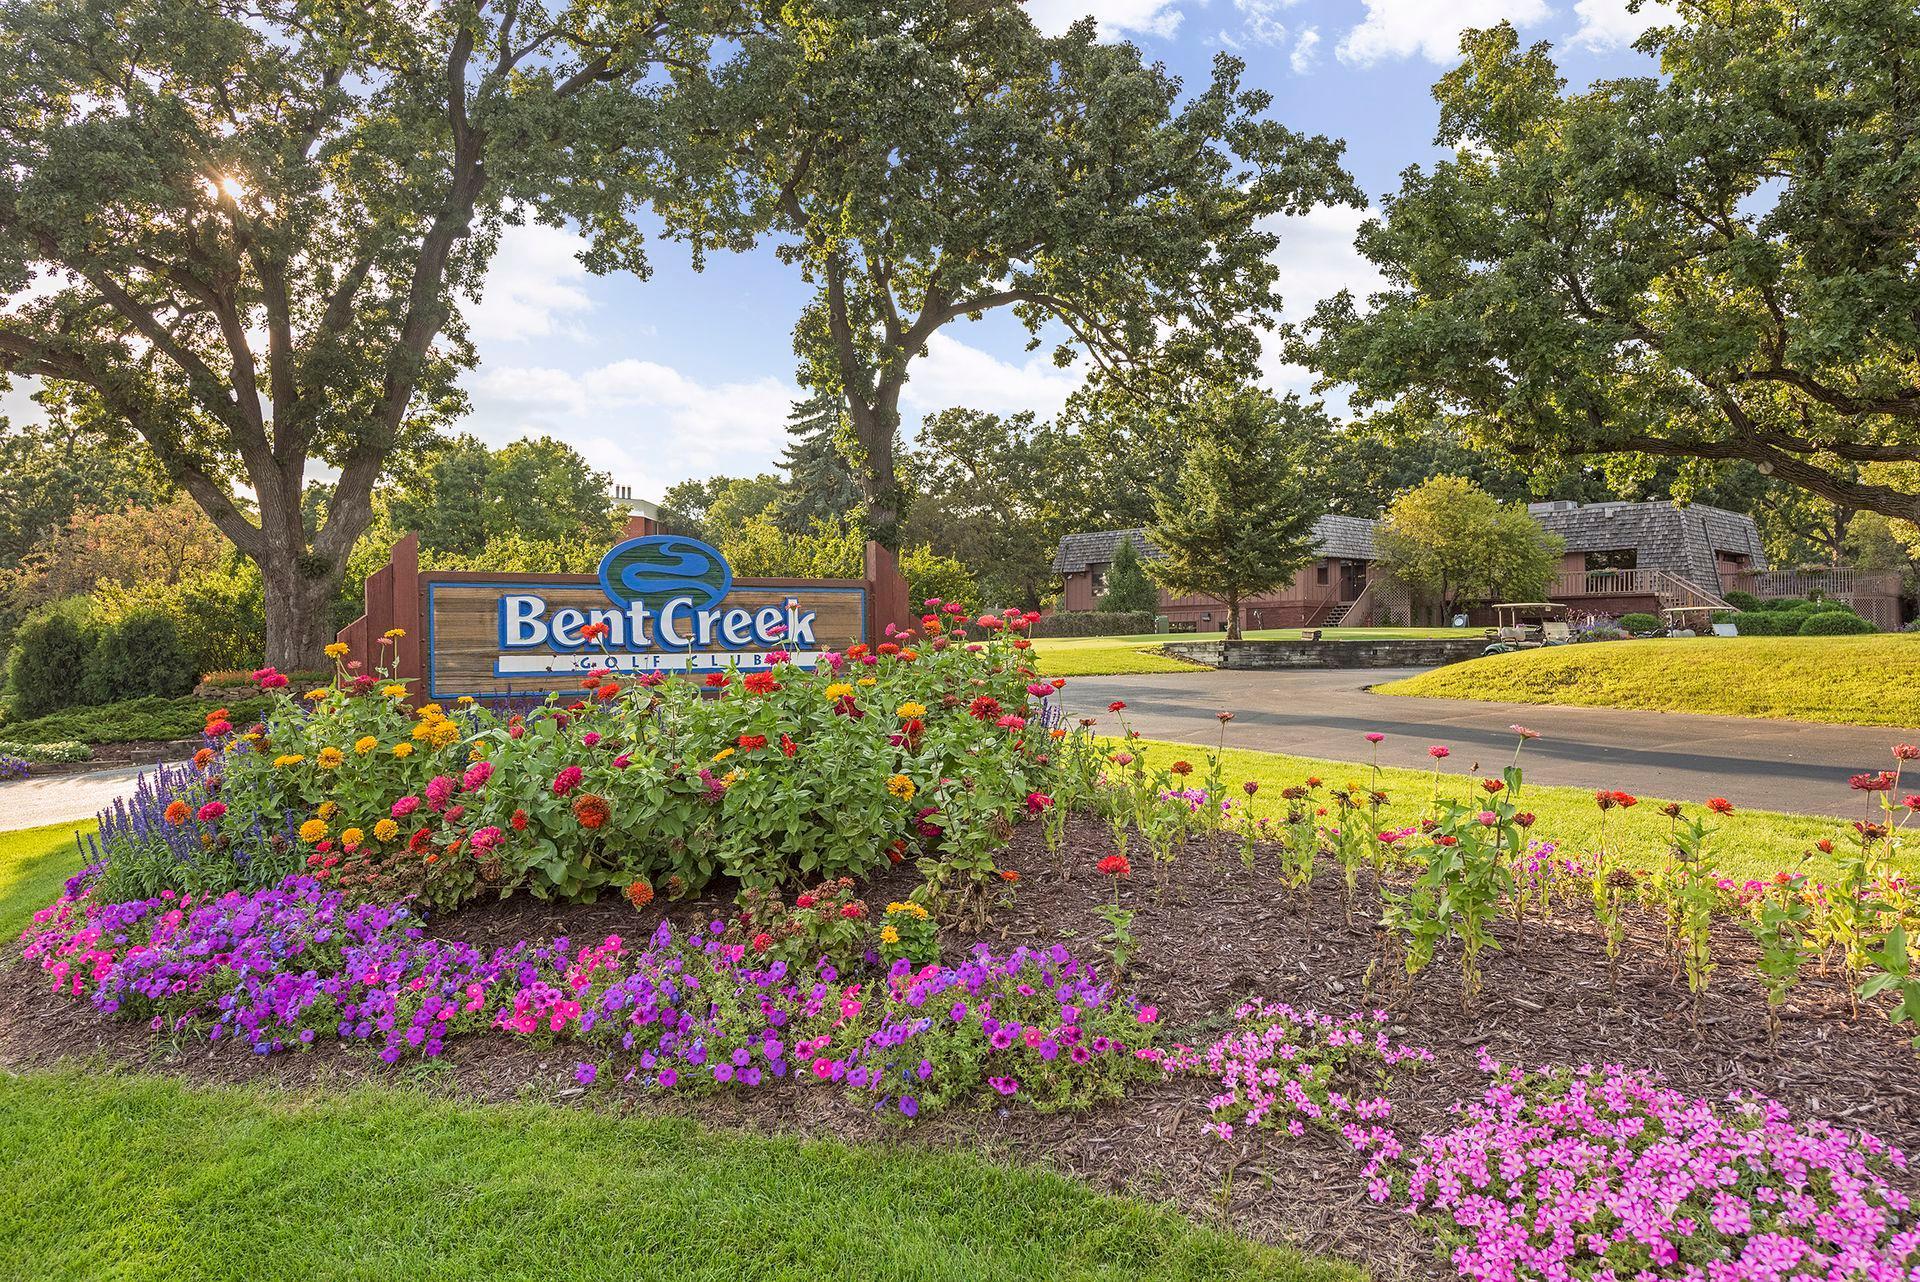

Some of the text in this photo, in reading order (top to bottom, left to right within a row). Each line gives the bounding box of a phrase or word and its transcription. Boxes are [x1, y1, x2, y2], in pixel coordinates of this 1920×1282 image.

[505, 595, 816, 646] Bent Creek
[580, 655, 762, 668] GOLF CLUB
